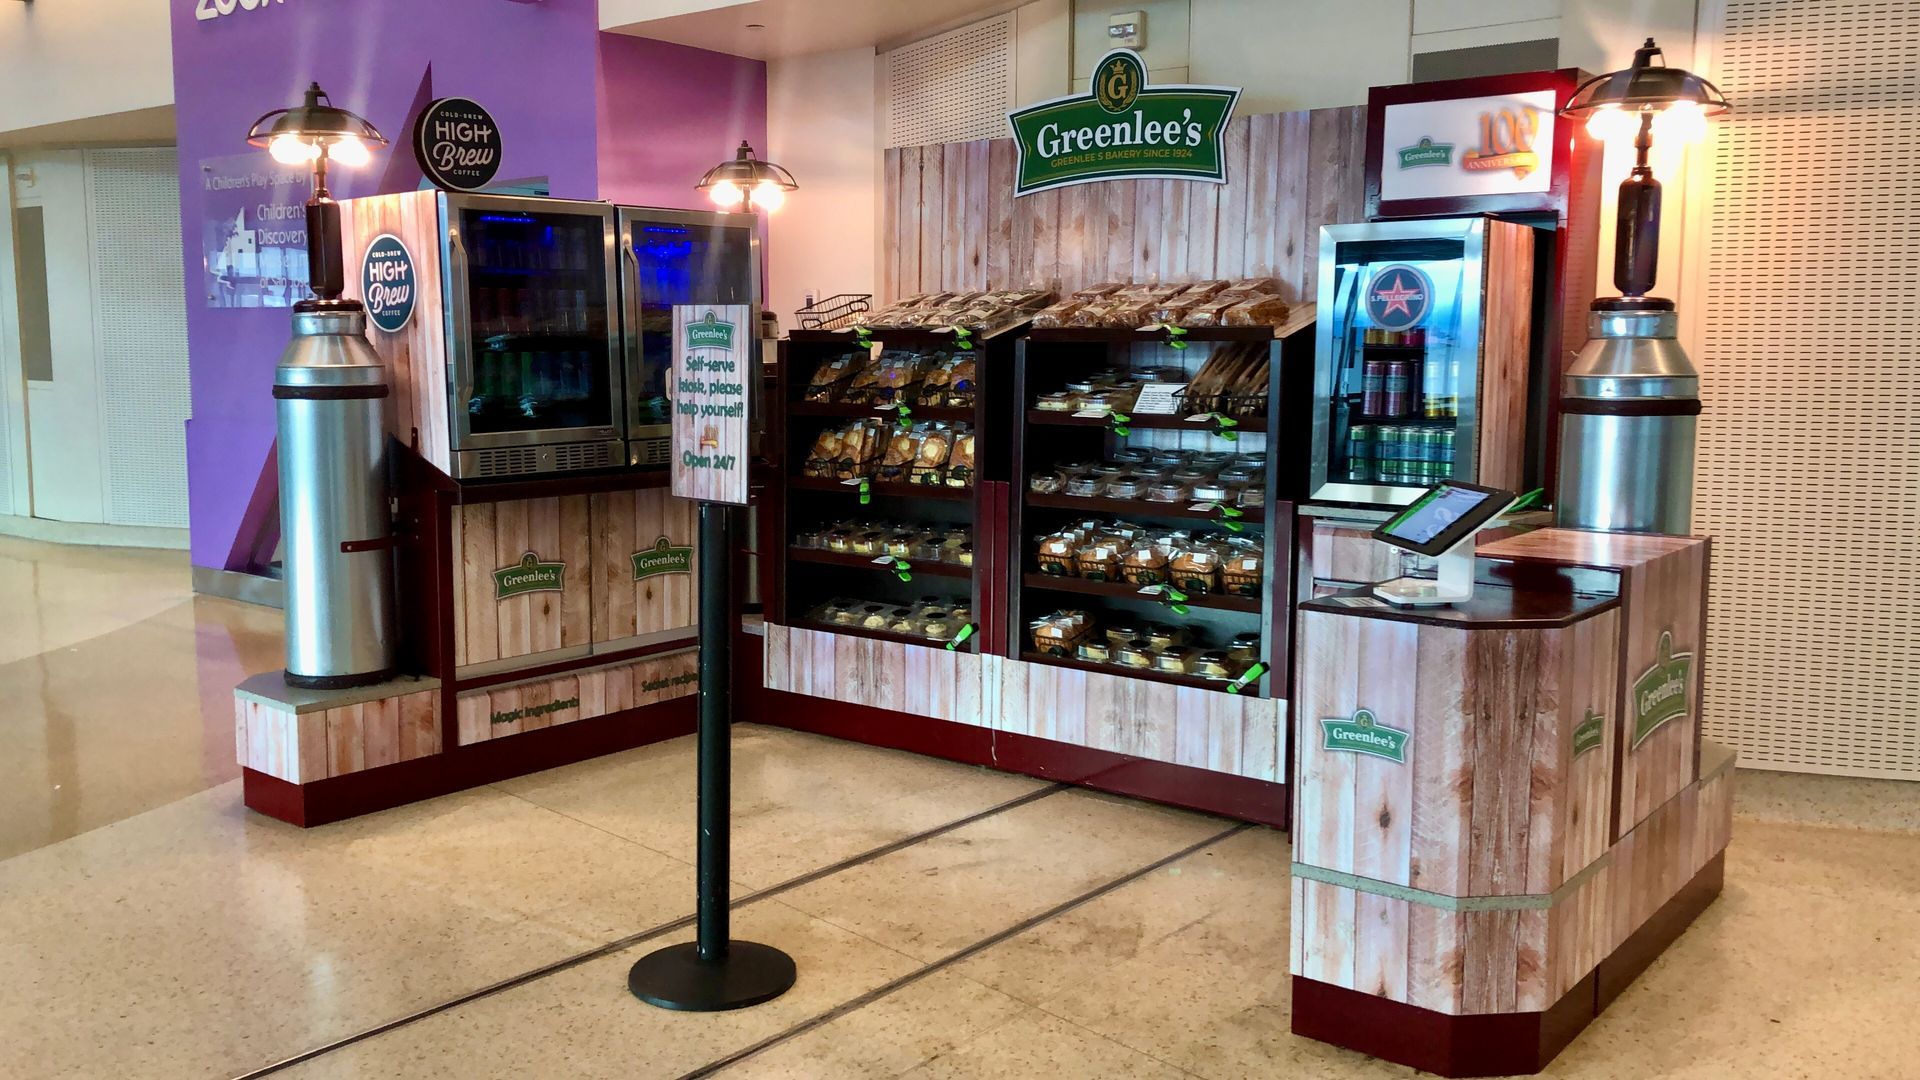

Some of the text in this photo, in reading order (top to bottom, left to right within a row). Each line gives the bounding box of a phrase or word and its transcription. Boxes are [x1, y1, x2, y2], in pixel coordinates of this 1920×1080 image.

[1107, 73, 1128, 100] G
[440, 111, 483, 120] COLD-BREW
[435, 120, 492, 143] HIGH
[1036, 107, 1202, 159] Greenlee's
[1479, 106, 1539, 155] 100
[433, 141, 494, 171] Brew
[1105, 150, 1141, 161] BAKERY
[1143, 149, 1171, 159] SINCE
[1172, 148, 1194, 158] 1924
[1403, 150, 1446, 163] Greenlee's
[453, 169, 480, 177] COFFEE
[256, 201, 307, 221] Children's
[258, 228, 308, 246] Discovery
[372, 250, 401, 258] COLD-BREW
[369, 260, 408, 282] HIGH
[368, 282, 410, 314] Brew
[382, 309, 401, 317] COFFEE
[692, 328, 728, 340] Greenlee's
[685, 355, 735, 373] Self-serve
[678, 377, 743, 397] kiosk, please
[676, 398, 744, 419] help yourself!
[682, 449, 736, 471] Open 24/7
[640, 552, 685, 570] Greenlee's
[503, 569, 556, 587] Greenlee's
[490, 707, 523, 725] Magic
[1332, 727, 1397, 750] Greenlee's
